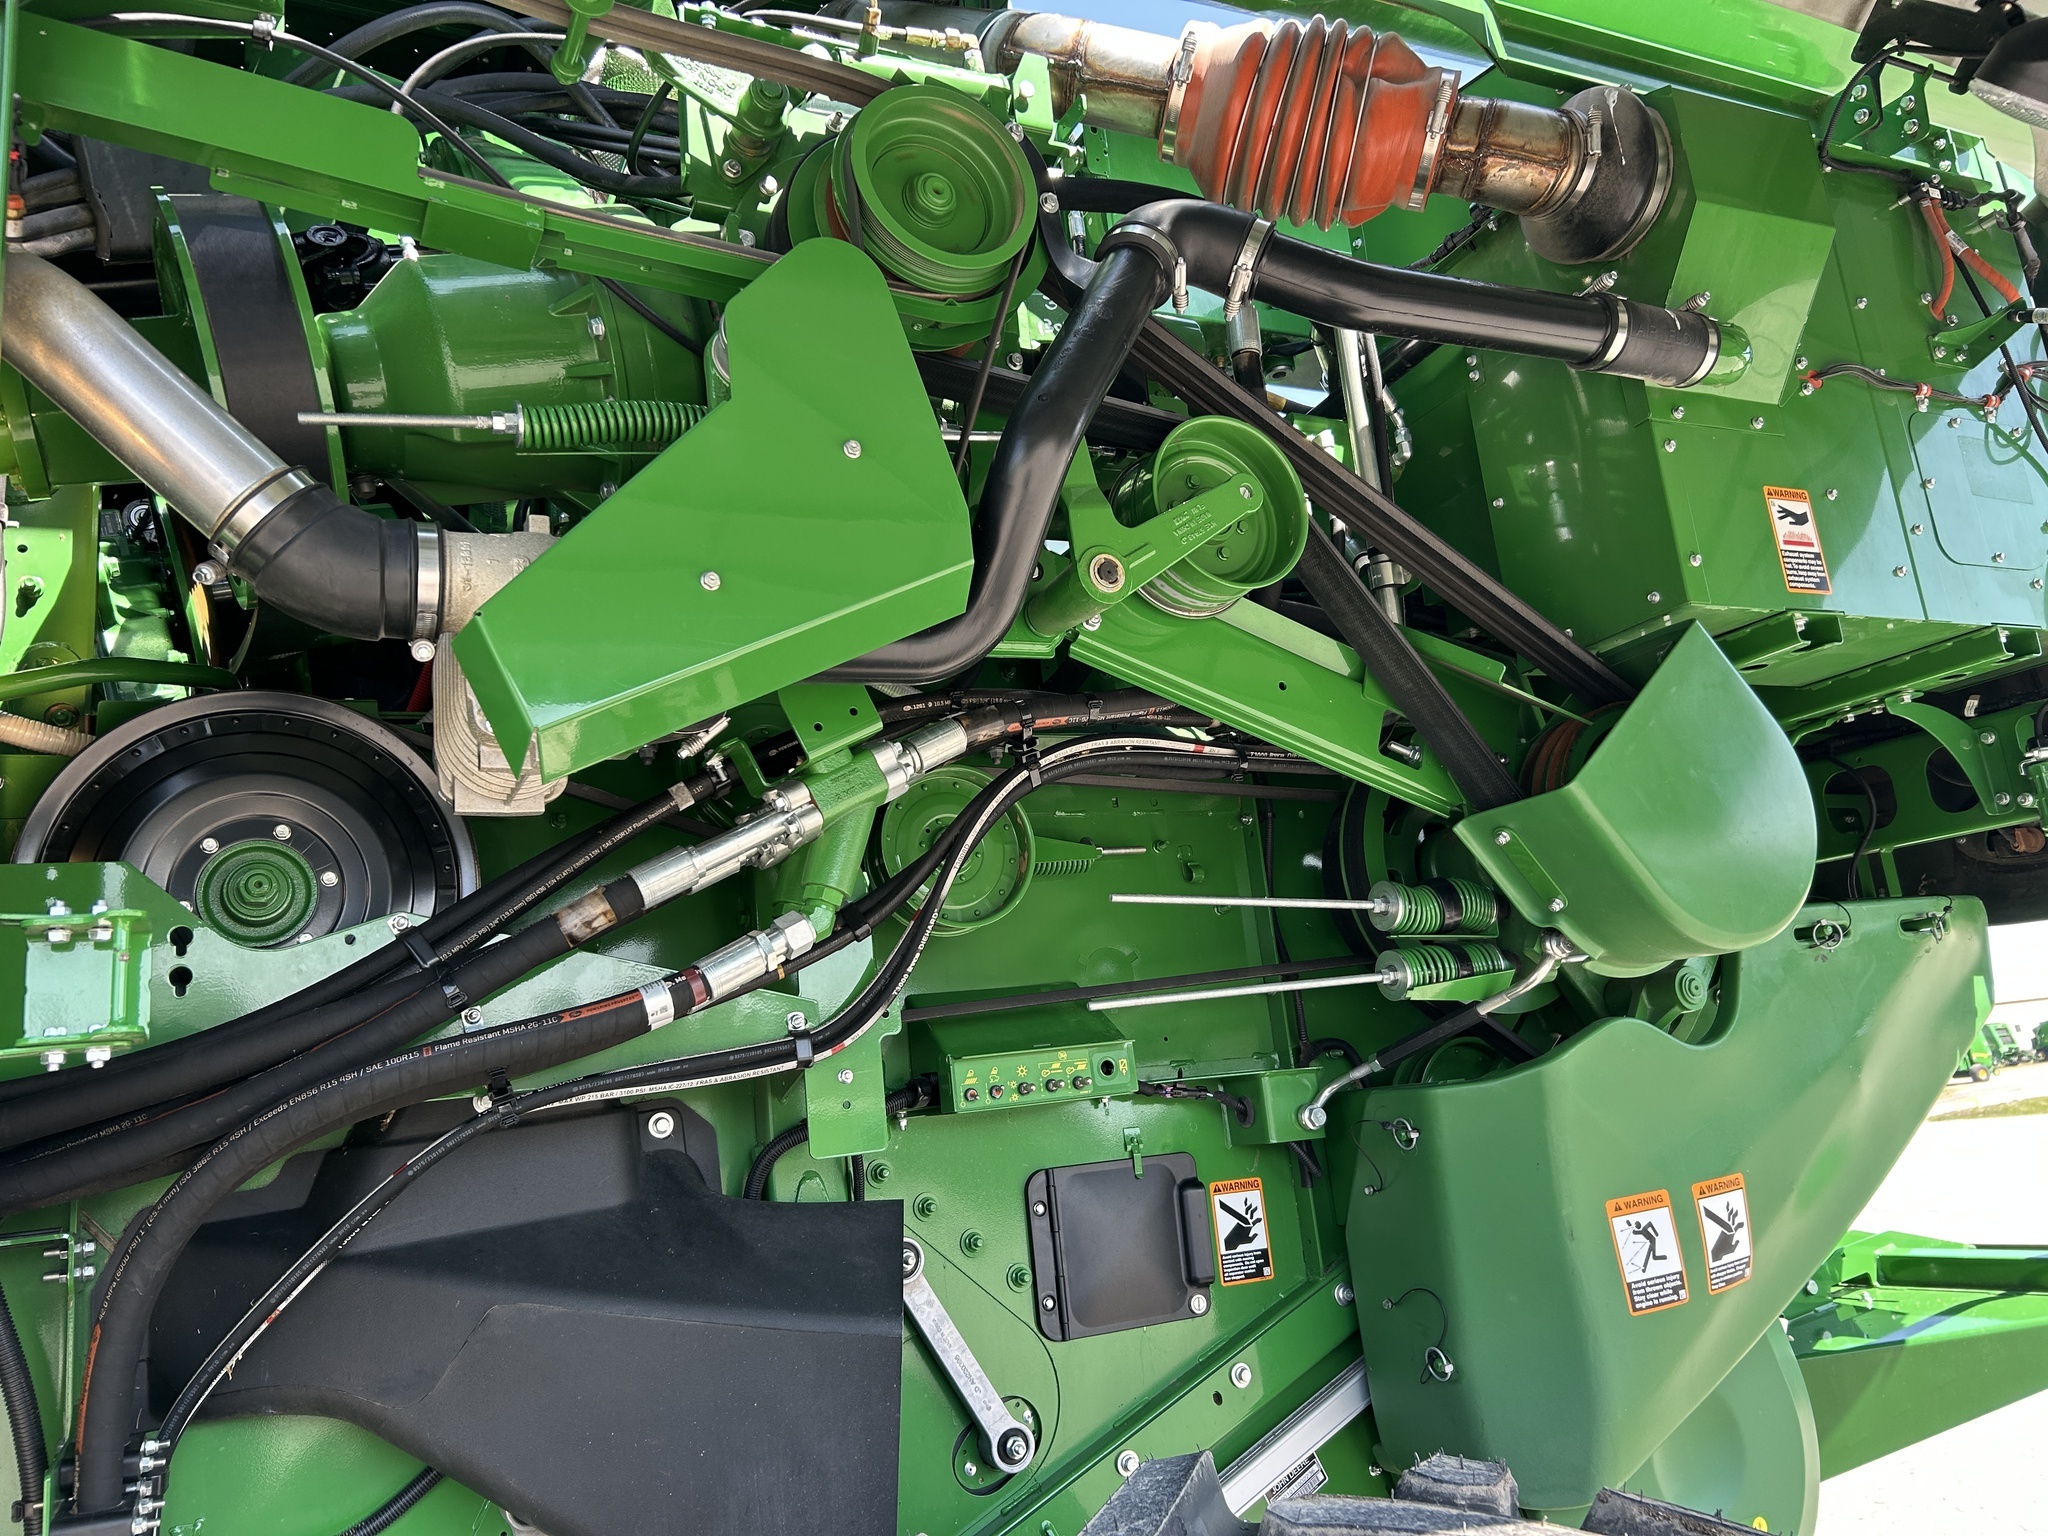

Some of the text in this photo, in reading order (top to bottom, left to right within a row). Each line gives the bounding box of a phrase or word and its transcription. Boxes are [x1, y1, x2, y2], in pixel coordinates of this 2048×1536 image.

[1773, 489, 1807, 500] WARNING
[601, 839, 614, 849] SAE
[631, 816, 649, 829] Flame
[646, 803, 672, 820] Resistant
[694, 1077, 713, 1085] FRAS
[718, 1070, 751, 1082] ABRASION
[750, 1062, 785, 1076] RESISTANT
[96, 1300, 109, 1321] 42.0
[104, 1280, 117, 1300] MPa
[176, 1170, 193, 1186] ISO
[210, 1139, 230, 1156] R15
[227, 1126, 248, 1143] 4SH
[245, 1122, 255, 1131] /
[251, 1101, 289, 1126] Exceeds
[288, 1087, 319, 1106] EN856
[318, 1078, 338, 1092] R15
[338, 1070, 358, 1084] 4SH
[357, 1068, 364, 1077] /
[364, 1061, 383, 1074] SAE
[383, 1048, 420, 1068] 100R15
[433, 1038, 461, 1053] Flame
[461, 1029, 501, 1046] Resistant
[501, 1022, 526, 1035] MSHA
[526, 1015, 558, 1029] 2G-11C
[1221, 1180, 1259, 1192] WARNING
[1706, 1178, 1740, 1193] WARNING
[1623, 1194, 1663, 1210] WARNING
[1272, 1474, 1290, 1494] JOHN
